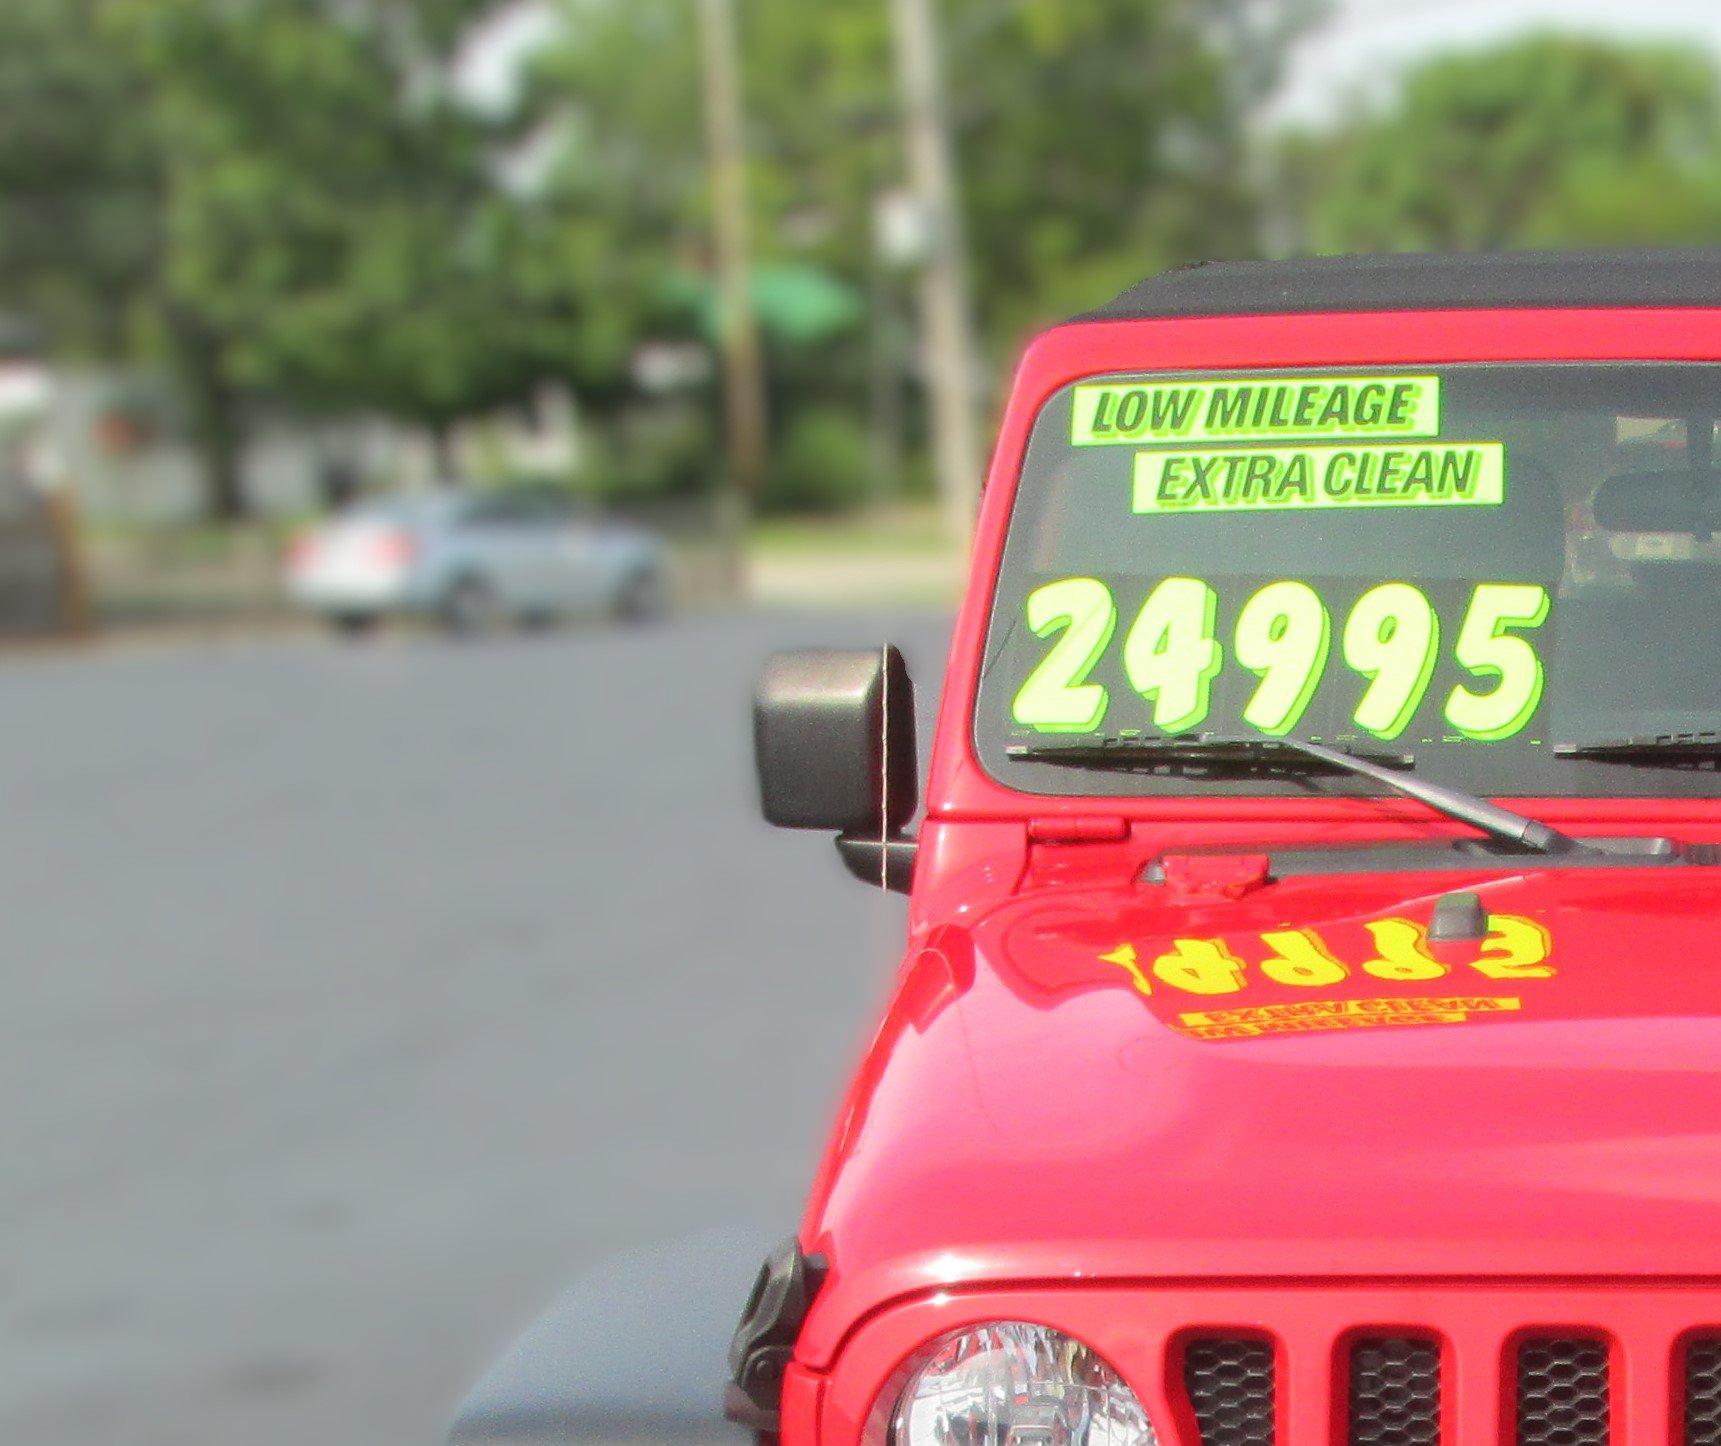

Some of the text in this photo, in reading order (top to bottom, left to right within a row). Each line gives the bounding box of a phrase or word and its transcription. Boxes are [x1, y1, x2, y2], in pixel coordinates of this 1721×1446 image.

[1090, 382, 1417, 436] LOW MILEAGE
[1156, 449, 1478, 503] EXTRA CLEAN
[1012, 576, 1551, 741] 24995
